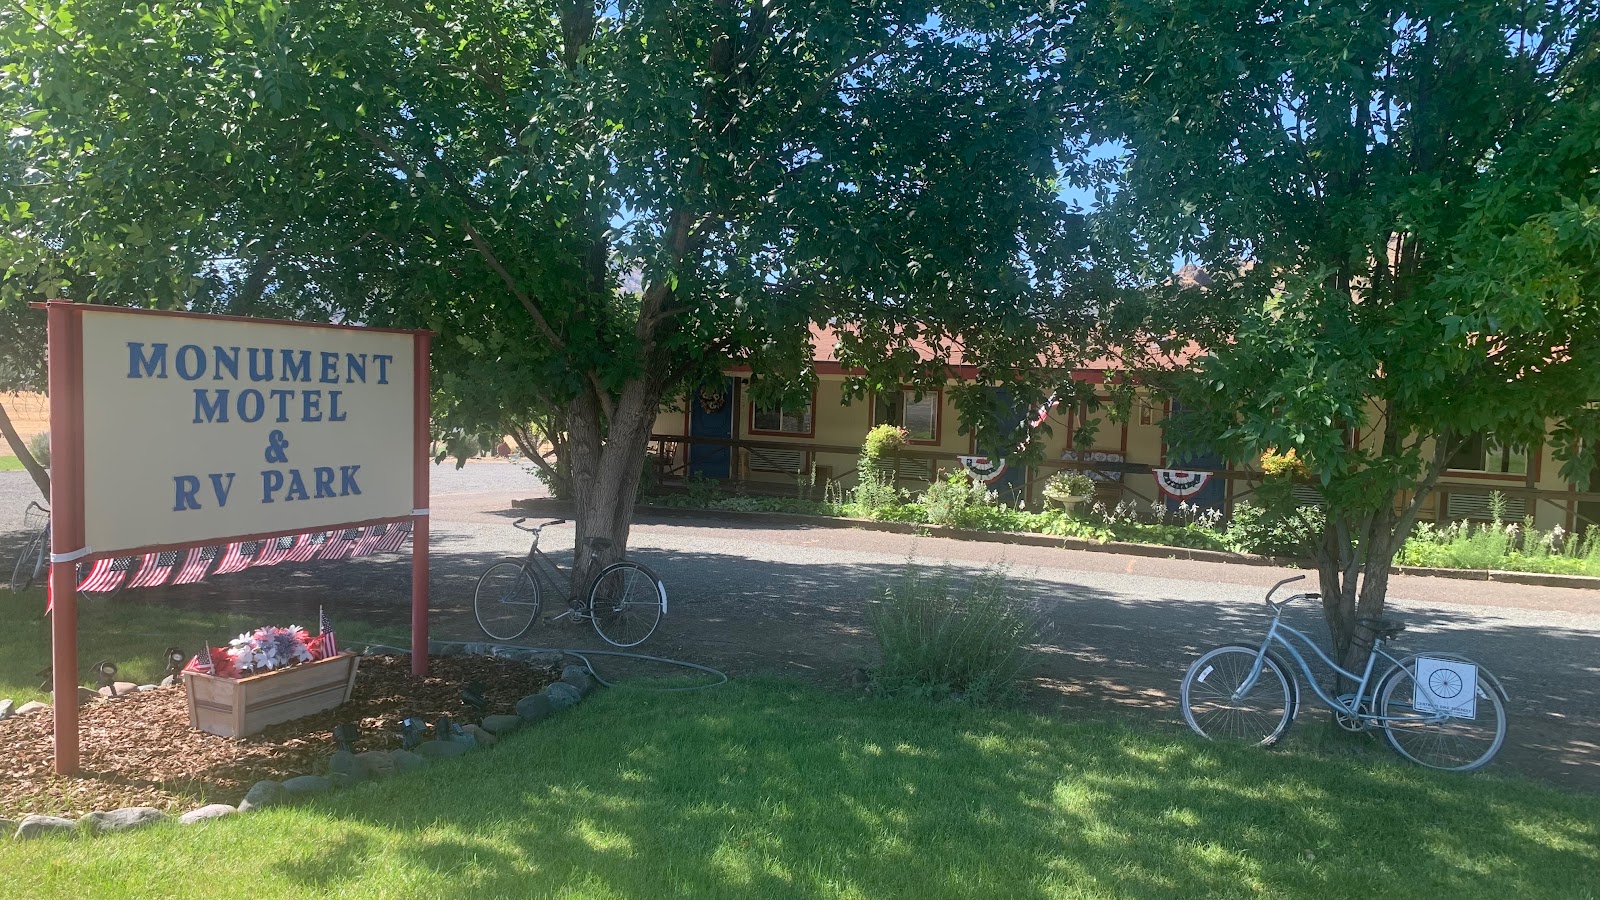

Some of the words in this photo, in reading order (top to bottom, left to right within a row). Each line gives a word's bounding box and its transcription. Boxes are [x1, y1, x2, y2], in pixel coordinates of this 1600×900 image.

[127, 341, 393, 385] MONUMENT
[192, 388, 348, 424] MOTEL
[264, 429, 289, 465] &
[173, 471, 237, 512] RV
[261, 464, 363, 505] PARK
